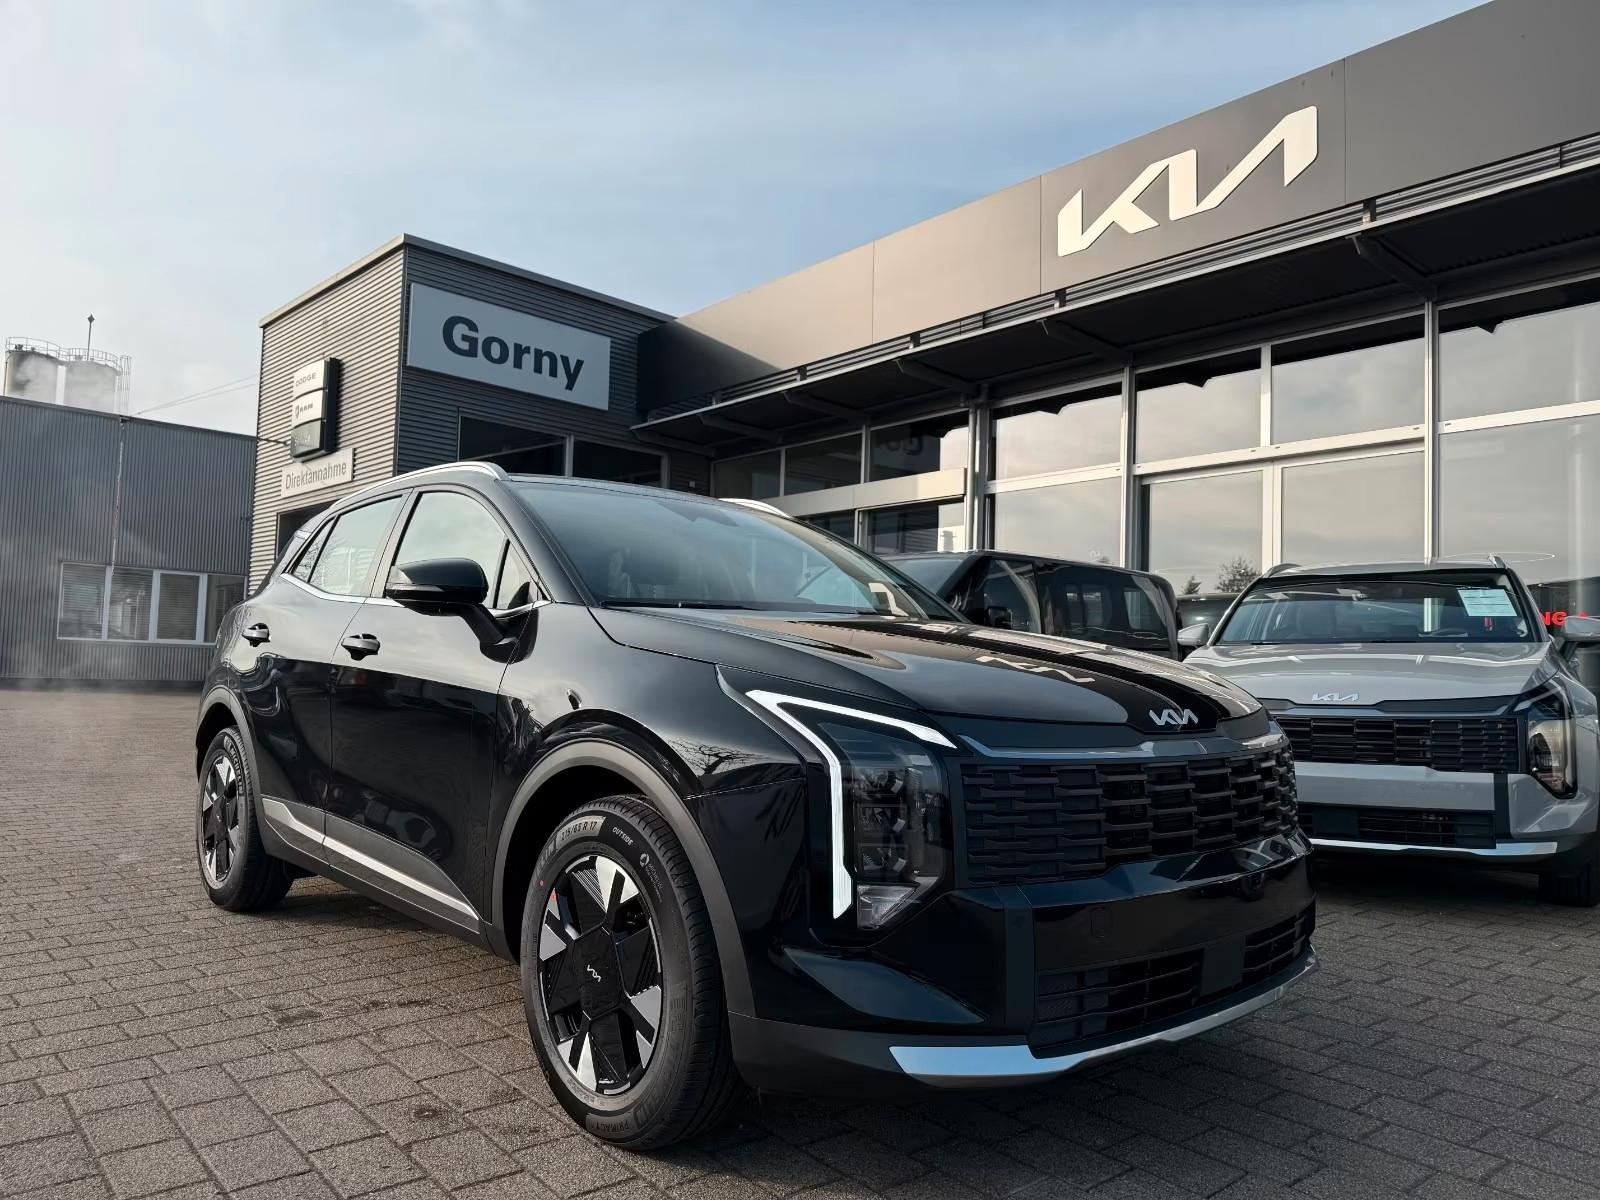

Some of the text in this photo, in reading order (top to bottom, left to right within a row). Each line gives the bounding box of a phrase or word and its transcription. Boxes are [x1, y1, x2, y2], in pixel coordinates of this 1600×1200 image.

[1058, 105, 1318, 257] KIA
[442, 315, 585, 392] Gorny
[295, 372, 317, 387] DODGE
[285, 461, 347, 490] Direktannahme
[583, 821, 588, 831] R
[589, 821, 598, 831] 17
[612, 826, 634, 846] OUTSIDE
